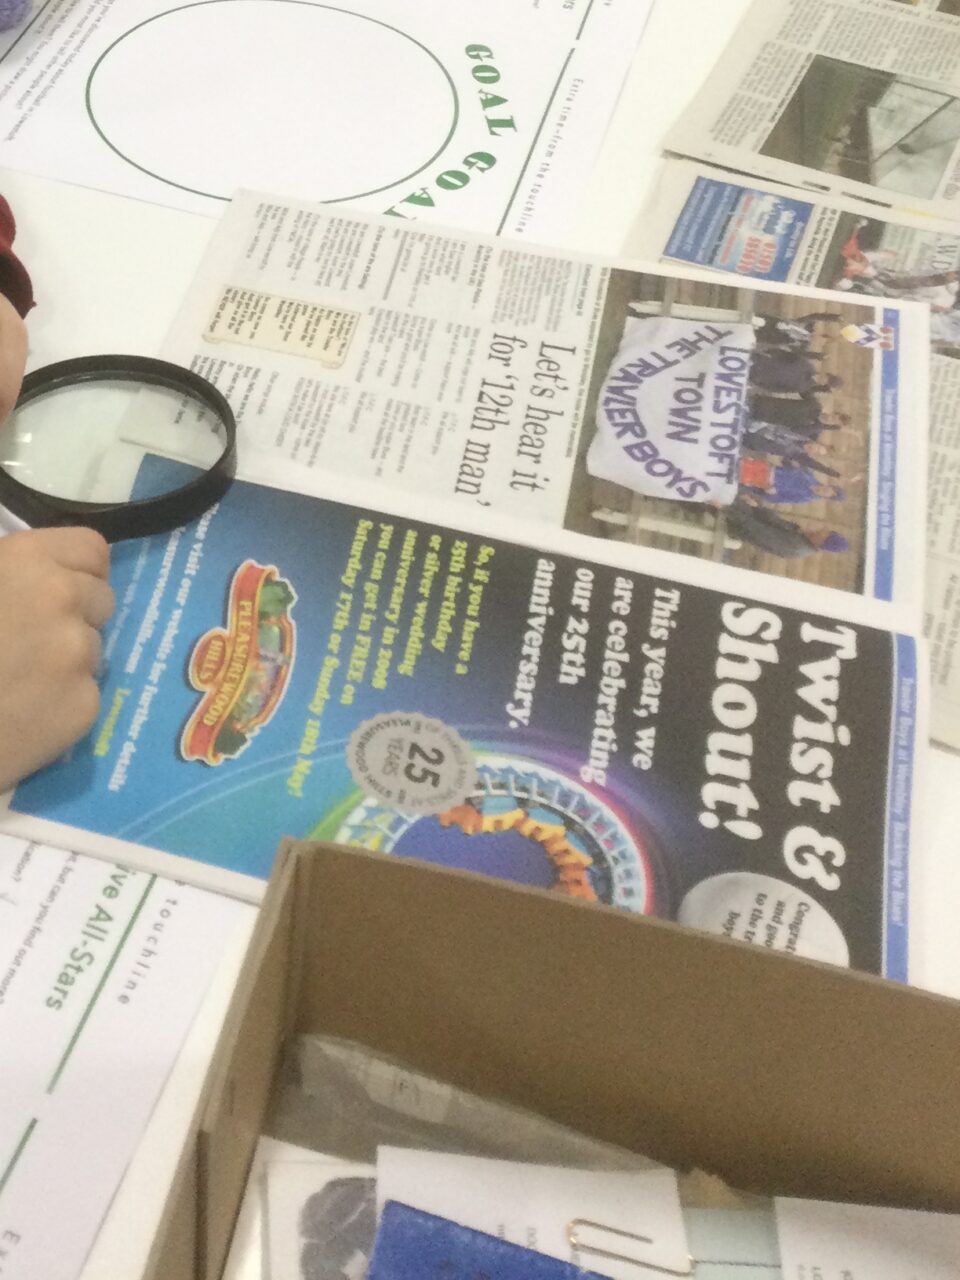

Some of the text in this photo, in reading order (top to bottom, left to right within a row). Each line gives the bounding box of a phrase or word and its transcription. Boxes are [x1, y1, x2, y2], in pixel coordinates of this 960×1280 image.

[464, 42, 518, 137] GOAL
[488, 332, 528, 368] for
[516, 404, 564, 462] hear
[509, 469, 550, 492] it
[616, 437, 716, 501] BOYS
[184, 542, 203, 576] visit
[340, 519, 374, 588] Saturday
[384, 529, 418, 624] anniversary
[473, 568, 490, 583] if
[176, 572, 196, 606] our
[333, 592, 353, 631] 17th
[397, 534, 442, 678] or silver wedding
[430, 540, 468, 653] 25th birthday
[458, 582, 487, 618] you
[156, 608, 183, 660] website
[340, 523, 394, 705] you can get in FREE on
[381, 626, 399, 645] in
[558, 568, 595, 685] our 25th
[199, 639, 226, 681] HILLS
[203, 597, 256, 727] PLEASUREWOOD
[328, 633, 342, 654] or
[458, 618, 480, 662] have
[494, 558, 556, 733] anniversary.
[148, 661, 167, 684] for
[308, 655, 340, 716] Sunday
[455, 663, 468, 674] a
[574, 576, 634, 788] are celebrating
[631, 588, 681, 771] This year, we
[128, 684, 159, 738] further
[698, 601, 783, 840] Shout!
[108, 740, 137, 791] details
[382, 738, 404, 776] YEARS
[403, 742, 445, 788] 25
[782, 622, 858, 891] Twist &
[46, 885, 61, 903] can
[57, 866, 74, 884] but
[35, 904, 50, 925] you
[749, 908, 763, 929] the
[755, 893, 768, 906] to
[23, 926, 42, 948] find
[764, 900, 786, 948] and goo
[785, 902, 810, 952] Congrat
[12, 948, 27, 967] out
[46, 903, 114, 1010] All-Stars
[117, 898, 178, 1005] touchline
